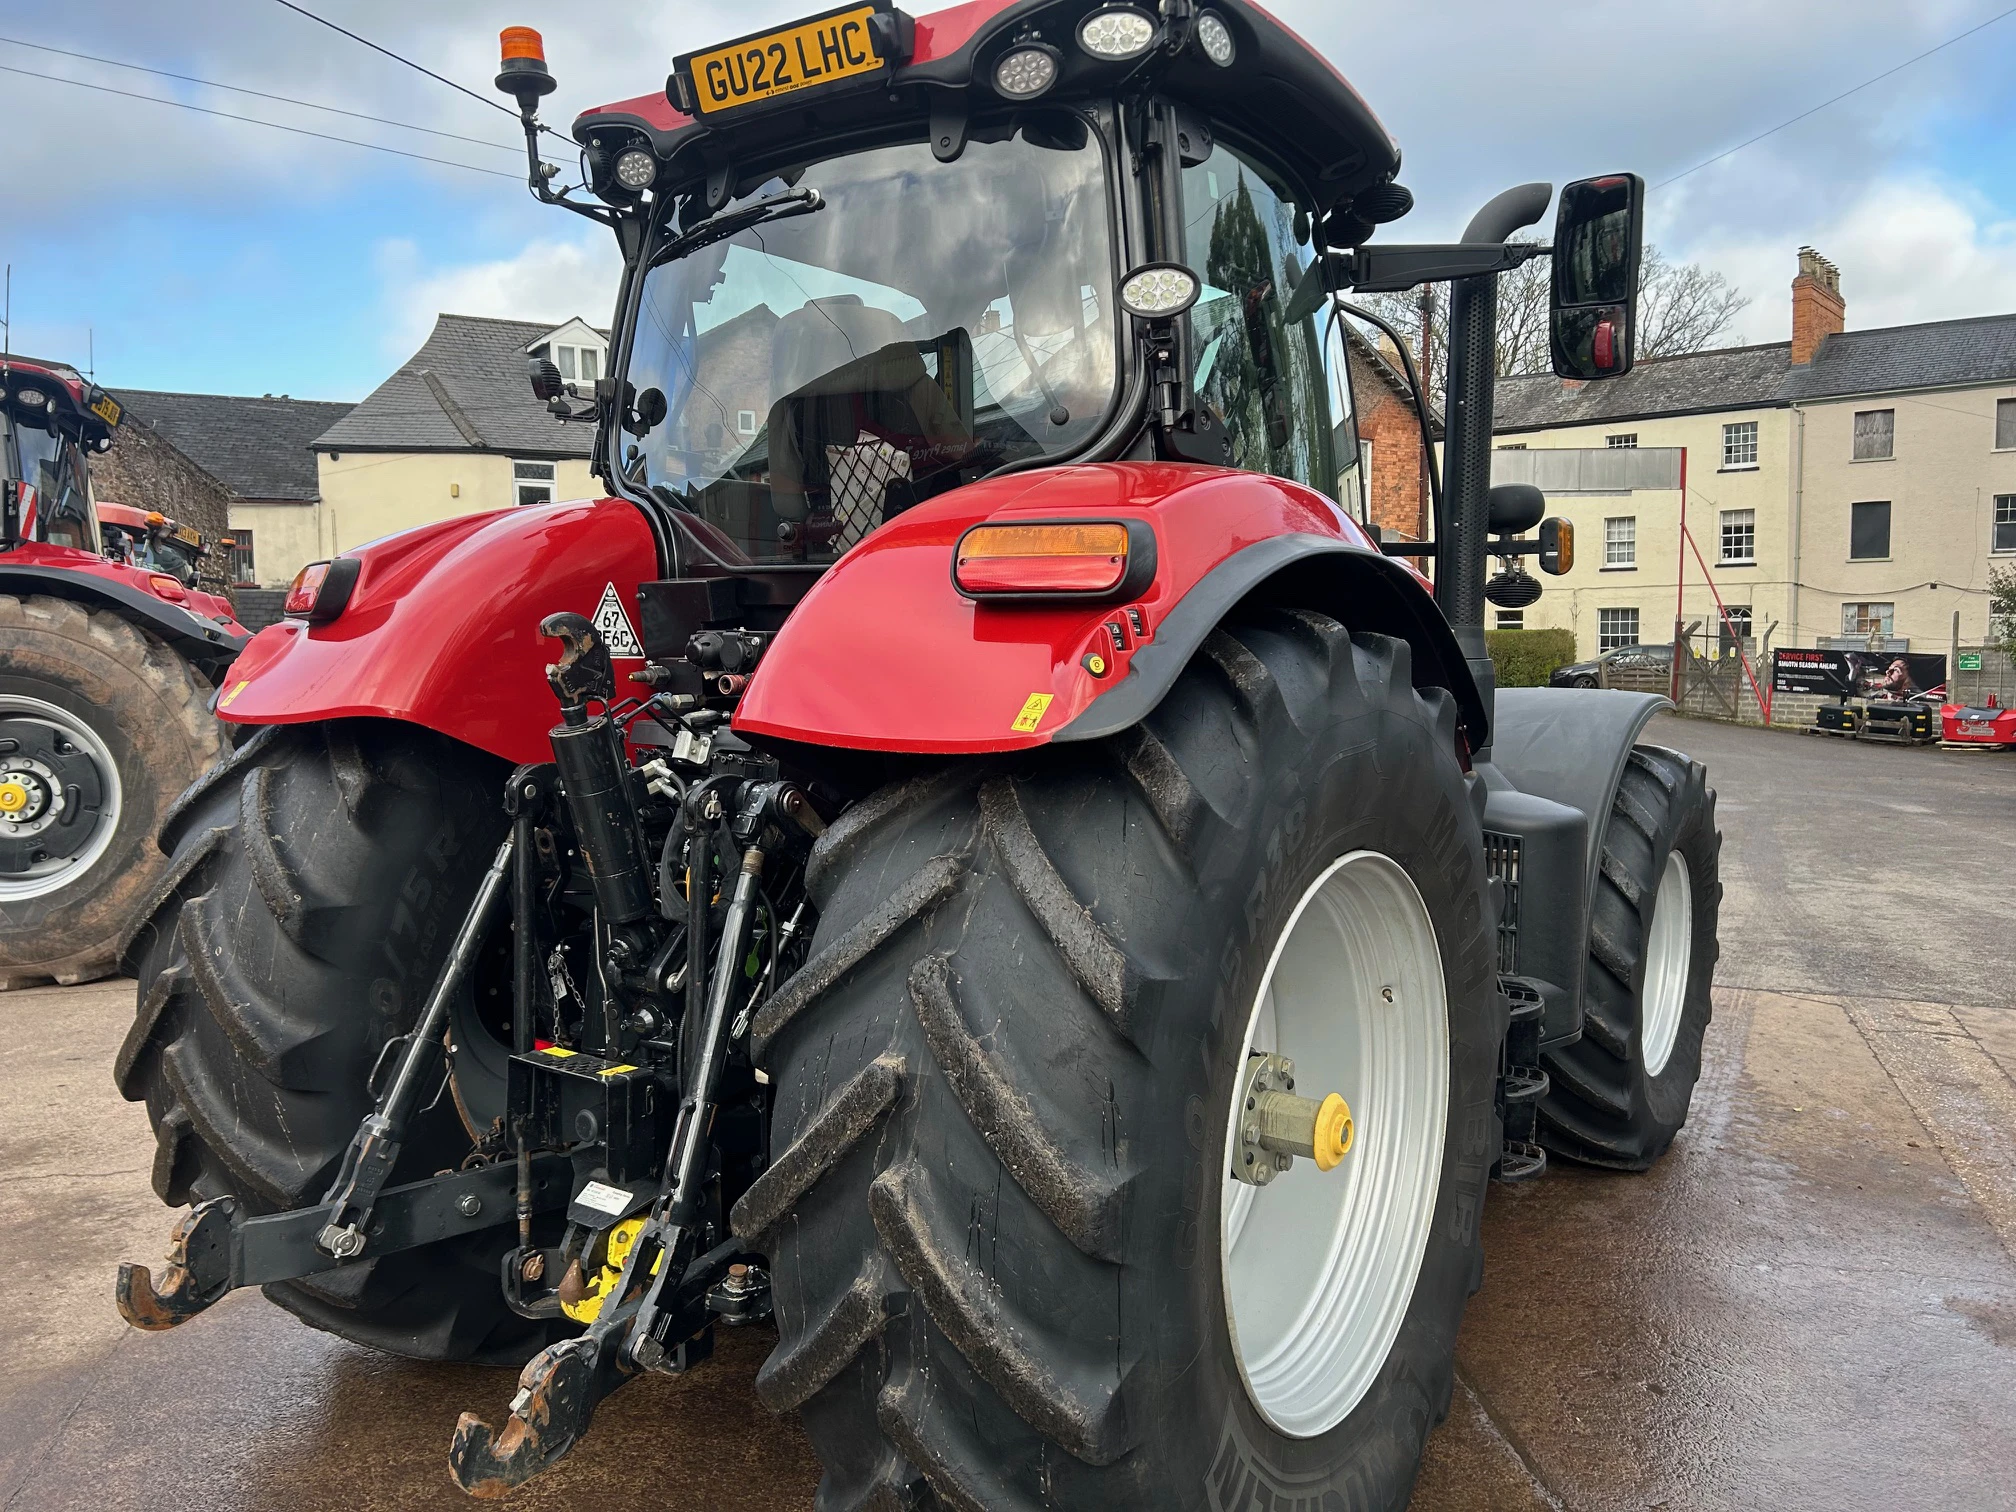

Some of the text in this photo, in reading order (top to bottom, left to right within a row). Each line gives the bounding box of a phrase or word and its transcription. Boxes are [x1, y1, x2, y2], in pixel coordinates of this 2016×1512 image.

[705, 20, 866, 102] GU22 LHC
[603, 611, 619, 628] 67
[1778, 652, 1804, 661] SERVICE
[1799, 661, 1818, 669] SEASON
